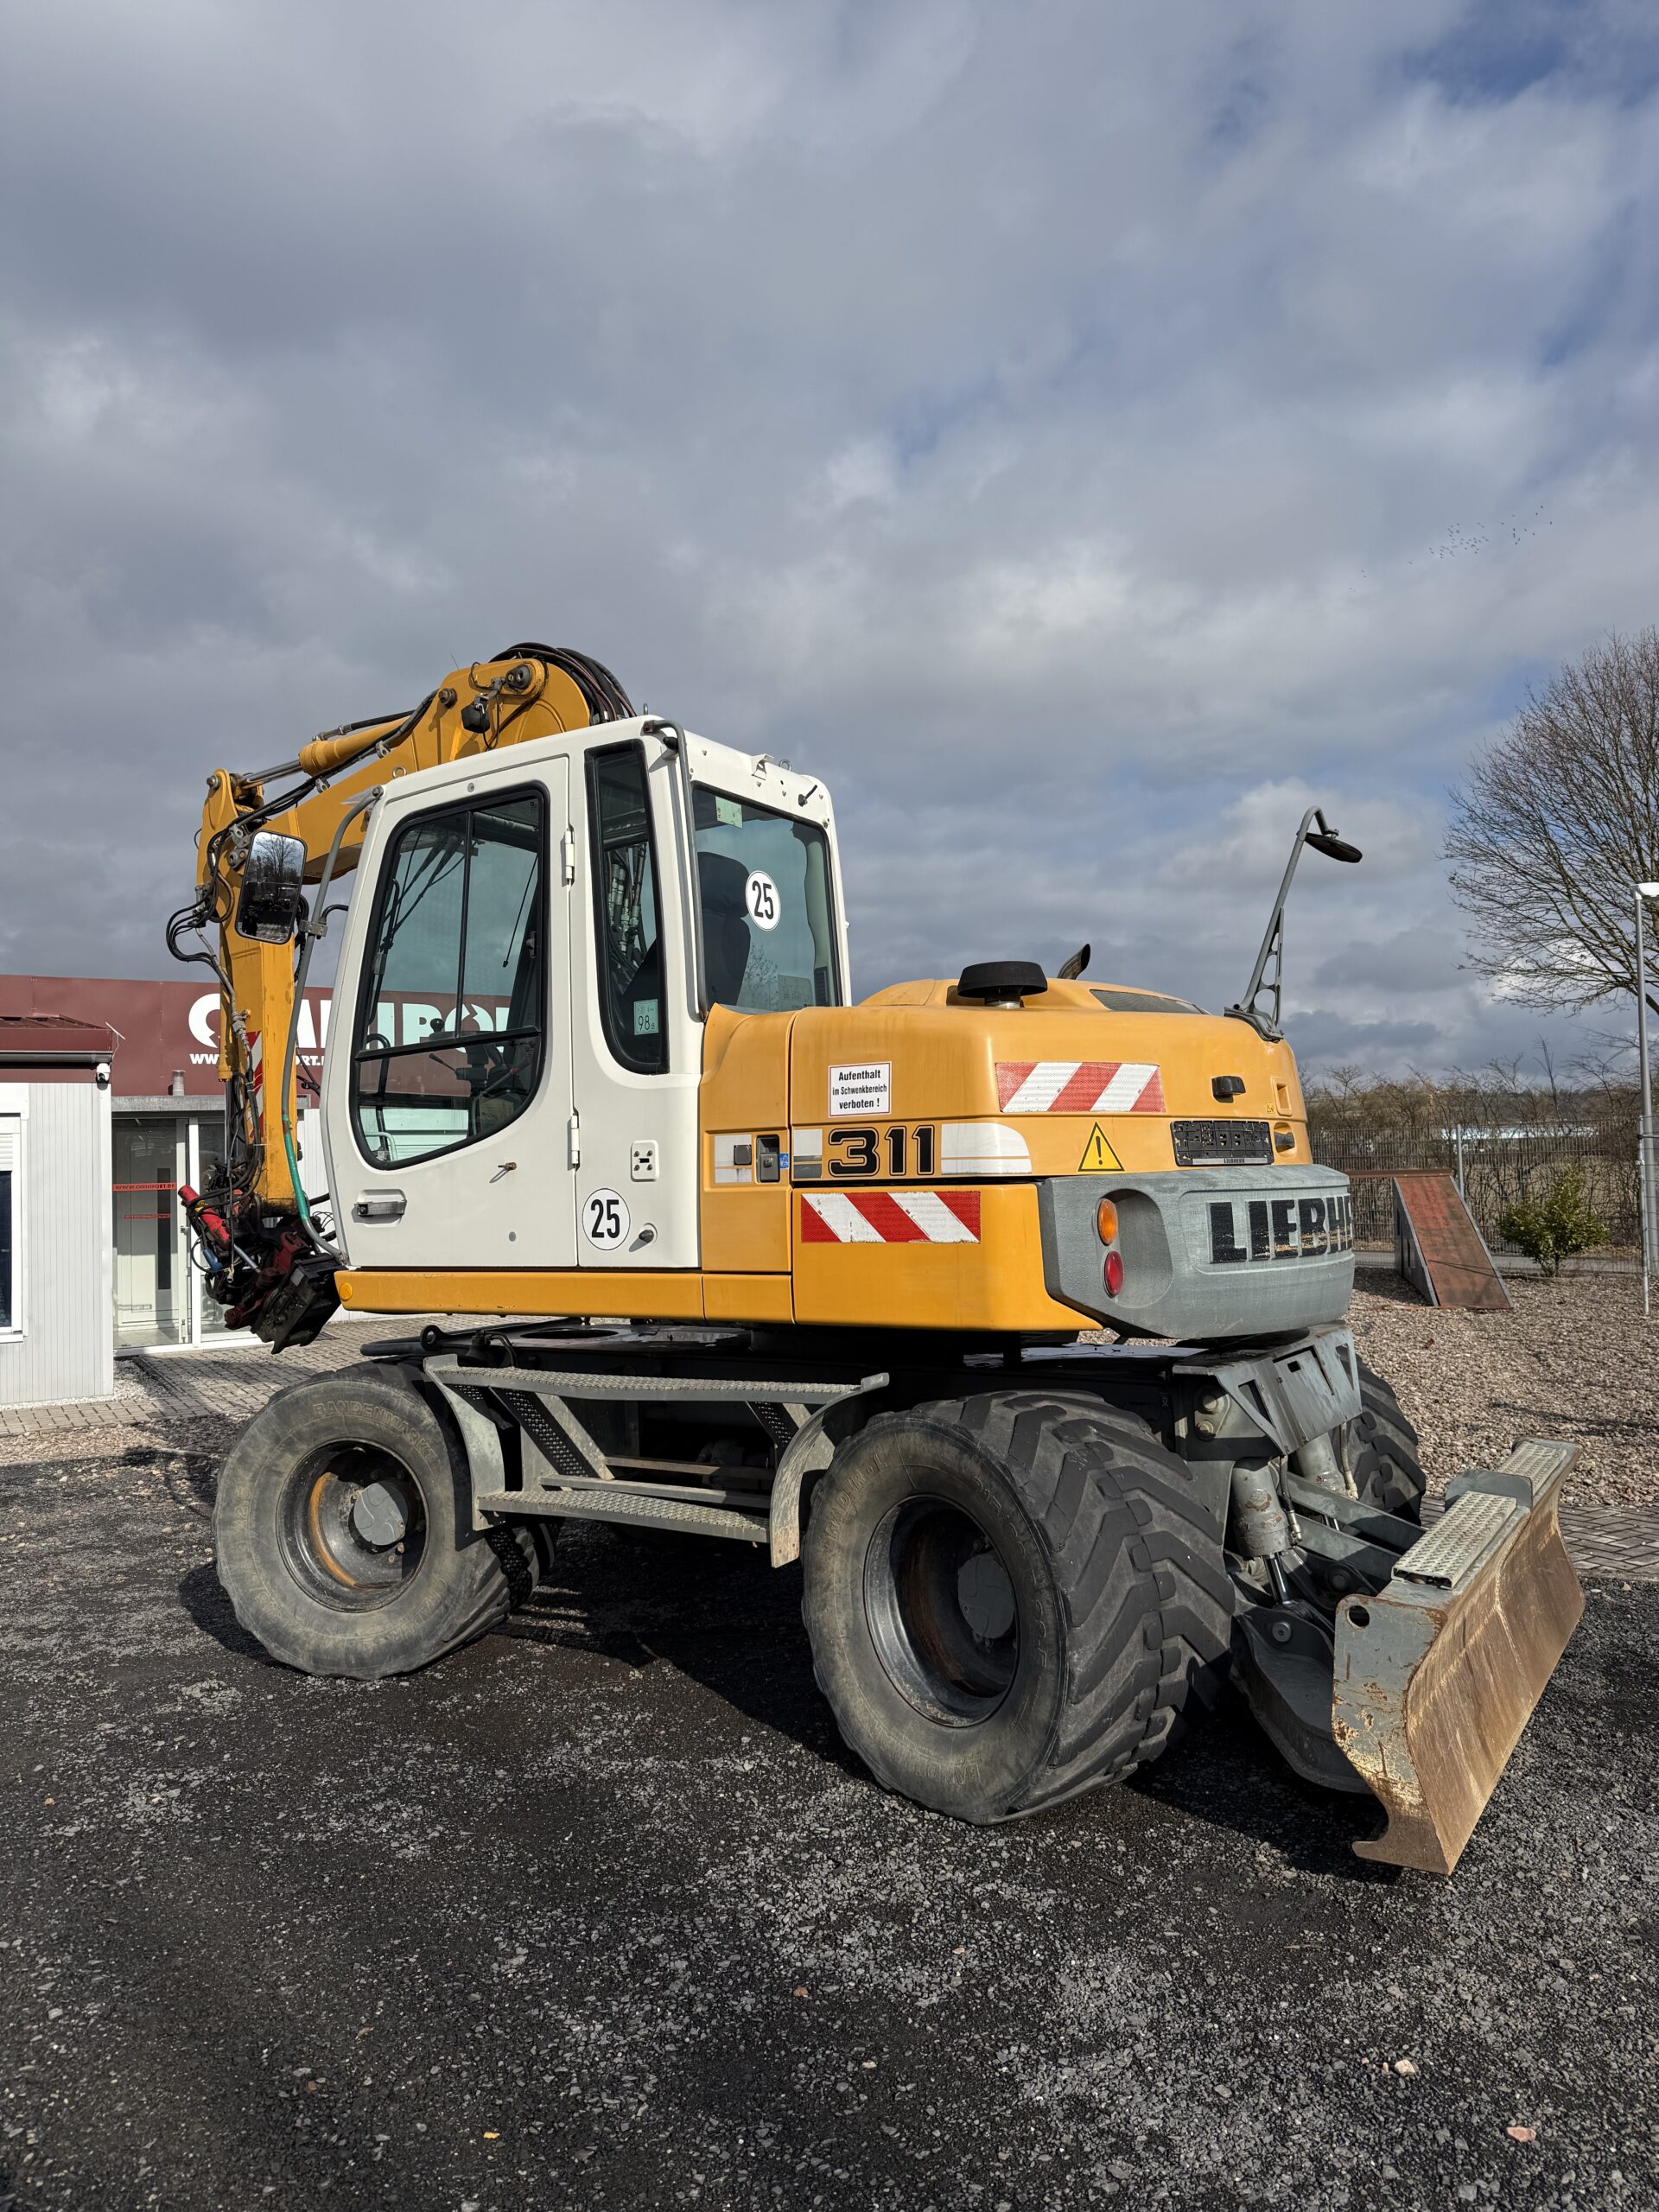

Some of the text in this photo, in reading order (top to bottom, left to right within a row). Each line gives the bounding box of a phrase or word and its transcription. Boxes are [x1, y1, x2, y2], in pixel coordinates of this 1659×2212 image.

[752, 880, 774, 920] 25
[638, 1014, 651, 1031] 98
[838, 1069, 881, 1082] Aufenthalt
[832, 1084, 887, 1096] im Schwenkbereich
[838, 1097, 880, 1109] verboten !
[828, 1124, 935, 1178] 311
[590, 1198, 620, 1239] 25
